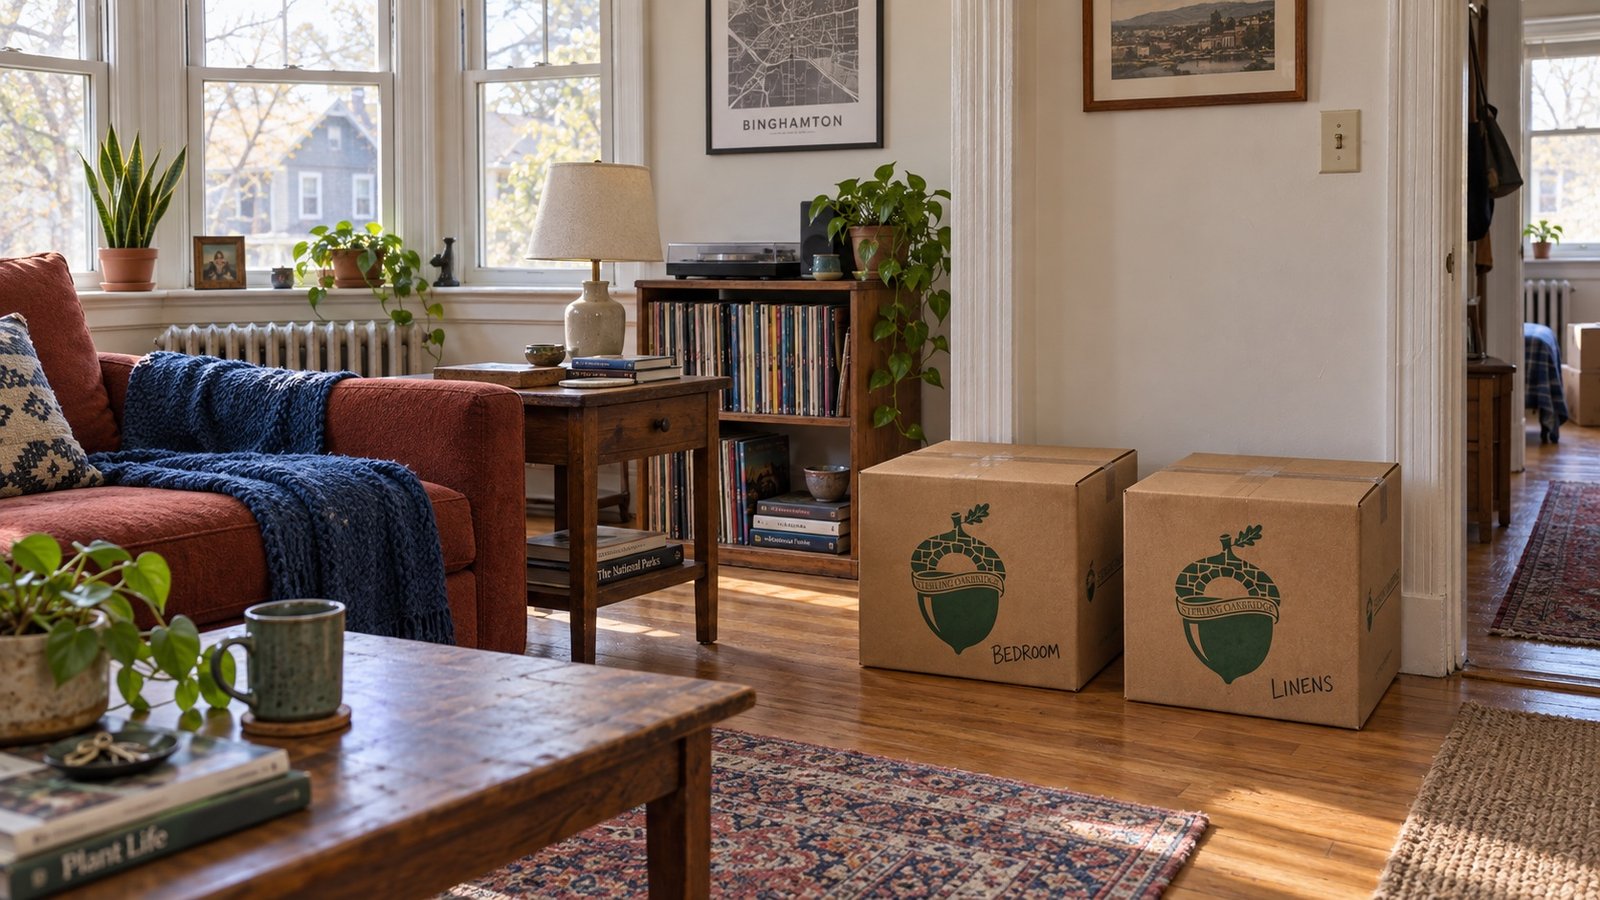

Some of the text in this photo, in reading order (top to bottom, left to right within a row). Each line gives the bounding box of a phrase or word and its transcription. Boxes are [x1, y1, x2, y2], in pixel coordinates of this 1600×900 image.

[743, 115, 842, 131] BINGHAMTON
[597, 556, 661, 581] The National Parks
[1181, 600, 1274, 616] STERLING OAKBRIDGE
[991, 643, 1060, 665] BEDROOM
[1271, 674, 1333, 699] LINENS
[61, 841, 123, 881] Plant
[126, 824, 169, 860] Life
